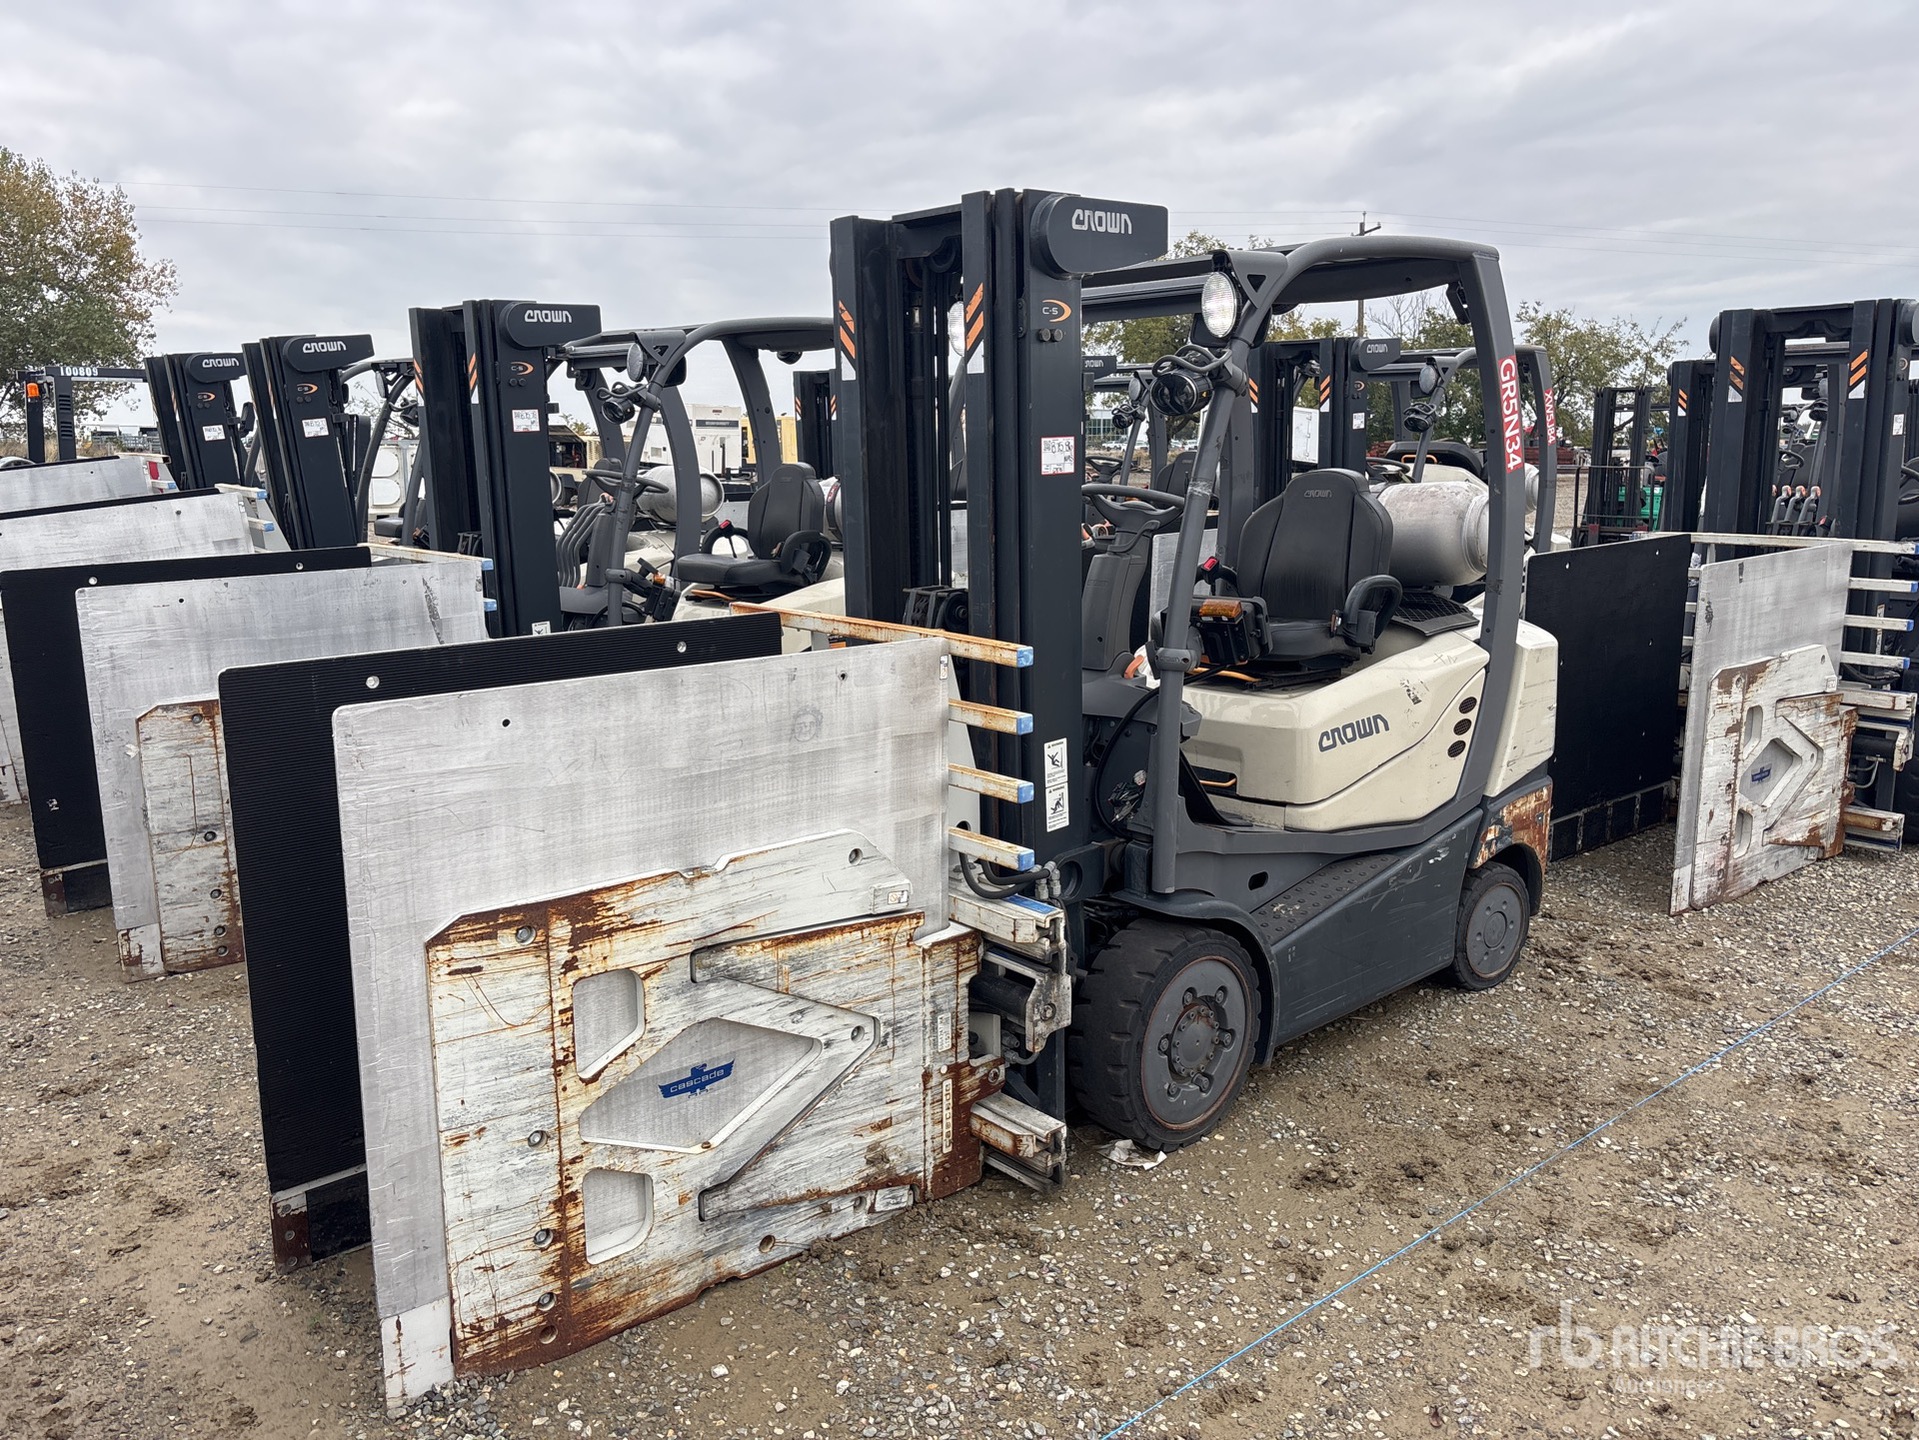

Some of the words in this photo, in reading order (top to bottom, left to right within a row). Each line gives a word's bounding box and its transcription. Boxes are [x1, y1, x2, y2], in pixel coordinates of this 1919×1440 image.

[1071, 208, 1132, 235] CROWN
[524, 309, 573, 323] CROWN
[302, 340, 347, 354] CROWN
[1366, 343, 1388, 353] CROWN
[202, 357, 240, 368] CROWN
[1084, 359, 1104, 368] ROWN
[60, 366, 98, 377] 100809
[1499, 358, 1522, 470] GR5N34
[1318, 713, 1390, 753] CROWN
[669, 1067, 725, 1094] cascade
